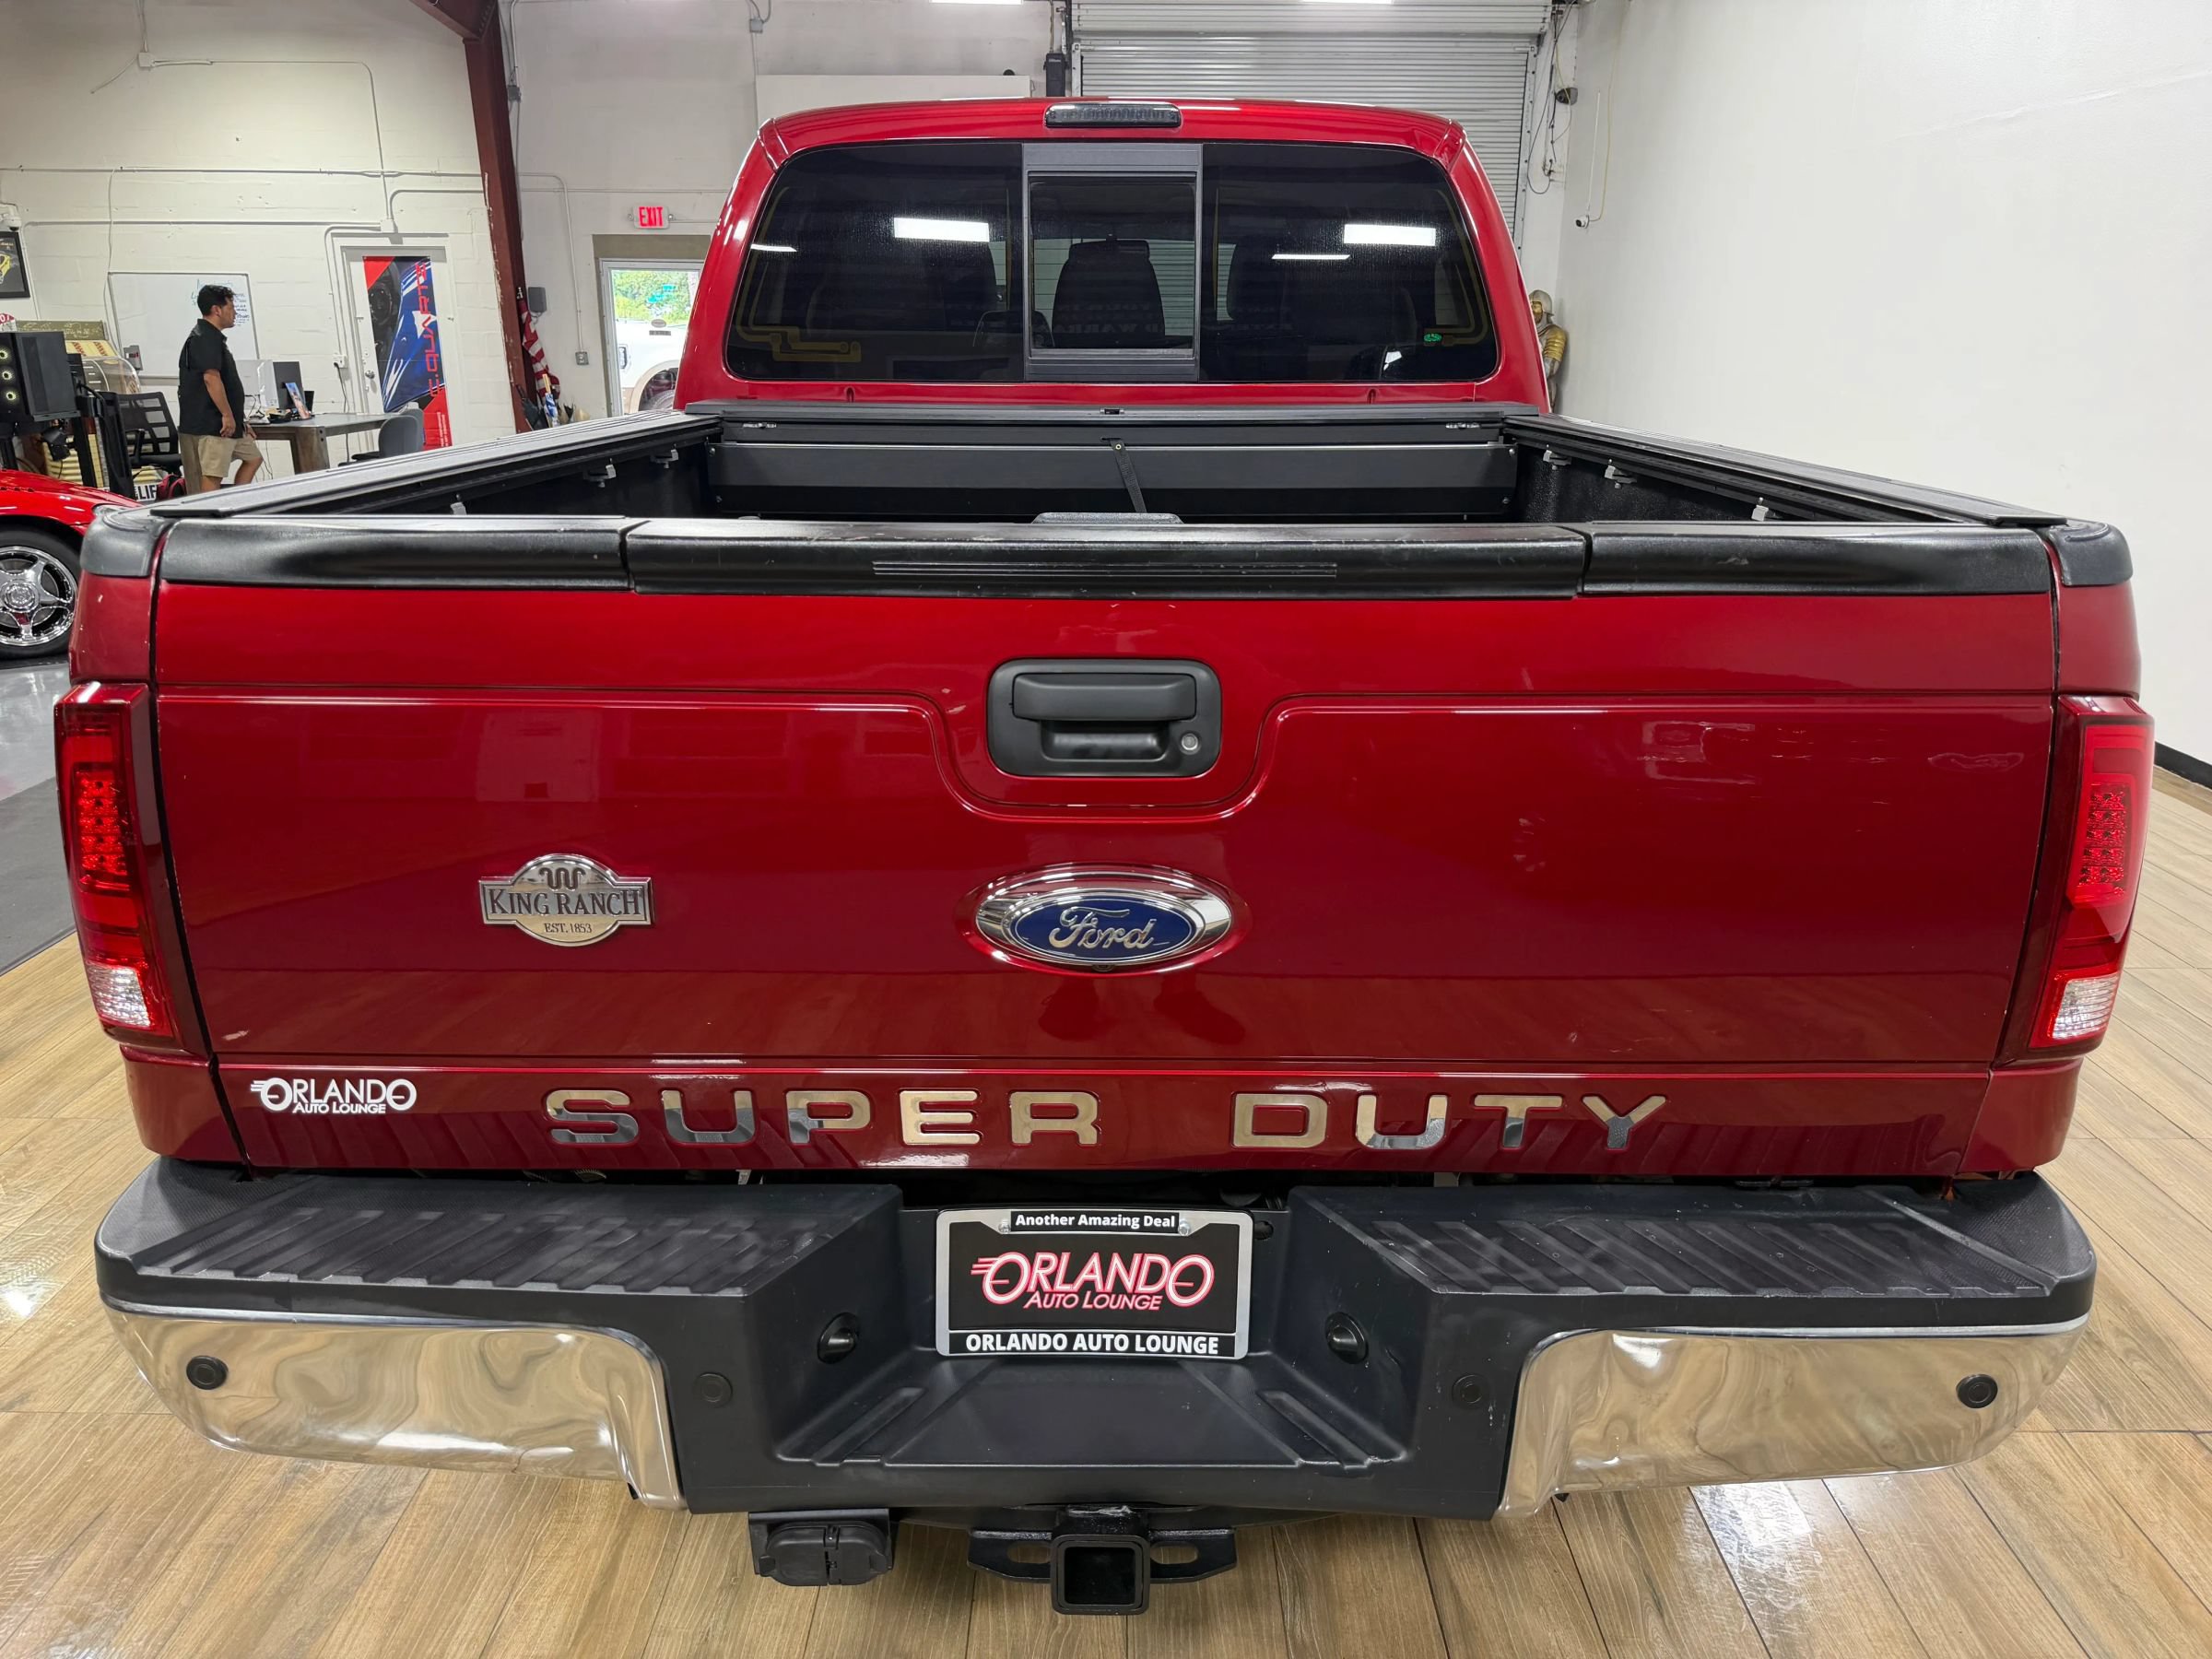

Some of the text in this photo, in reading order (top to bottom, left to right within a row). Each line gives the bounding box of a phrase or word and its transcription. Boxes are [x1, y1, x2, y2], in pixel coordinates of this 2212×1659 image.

[639, 206, 664, 228] EXIT
[488, 888, 642, 916] KING RANCH
[544, 923, 593, 934] EST. 1853
[1048, 906, 1159, 949] Ford
[252, 1077, 418, 1112] ORLANDO
[292, 1101, 387, 1114] AUTO LOUNGE
[545, 1089, 1666, 1150] SUPER DUTY
[1016, 1214, 1175, 1229] Another Amazing Deal
[971, 1252, 1216, 1308] ORLANDO
[1023, 1290, 1164, 1311] AUTO LOUNGE
[966, 1334, 1219, 1356] ORLANDO AUTO LOUNGE
